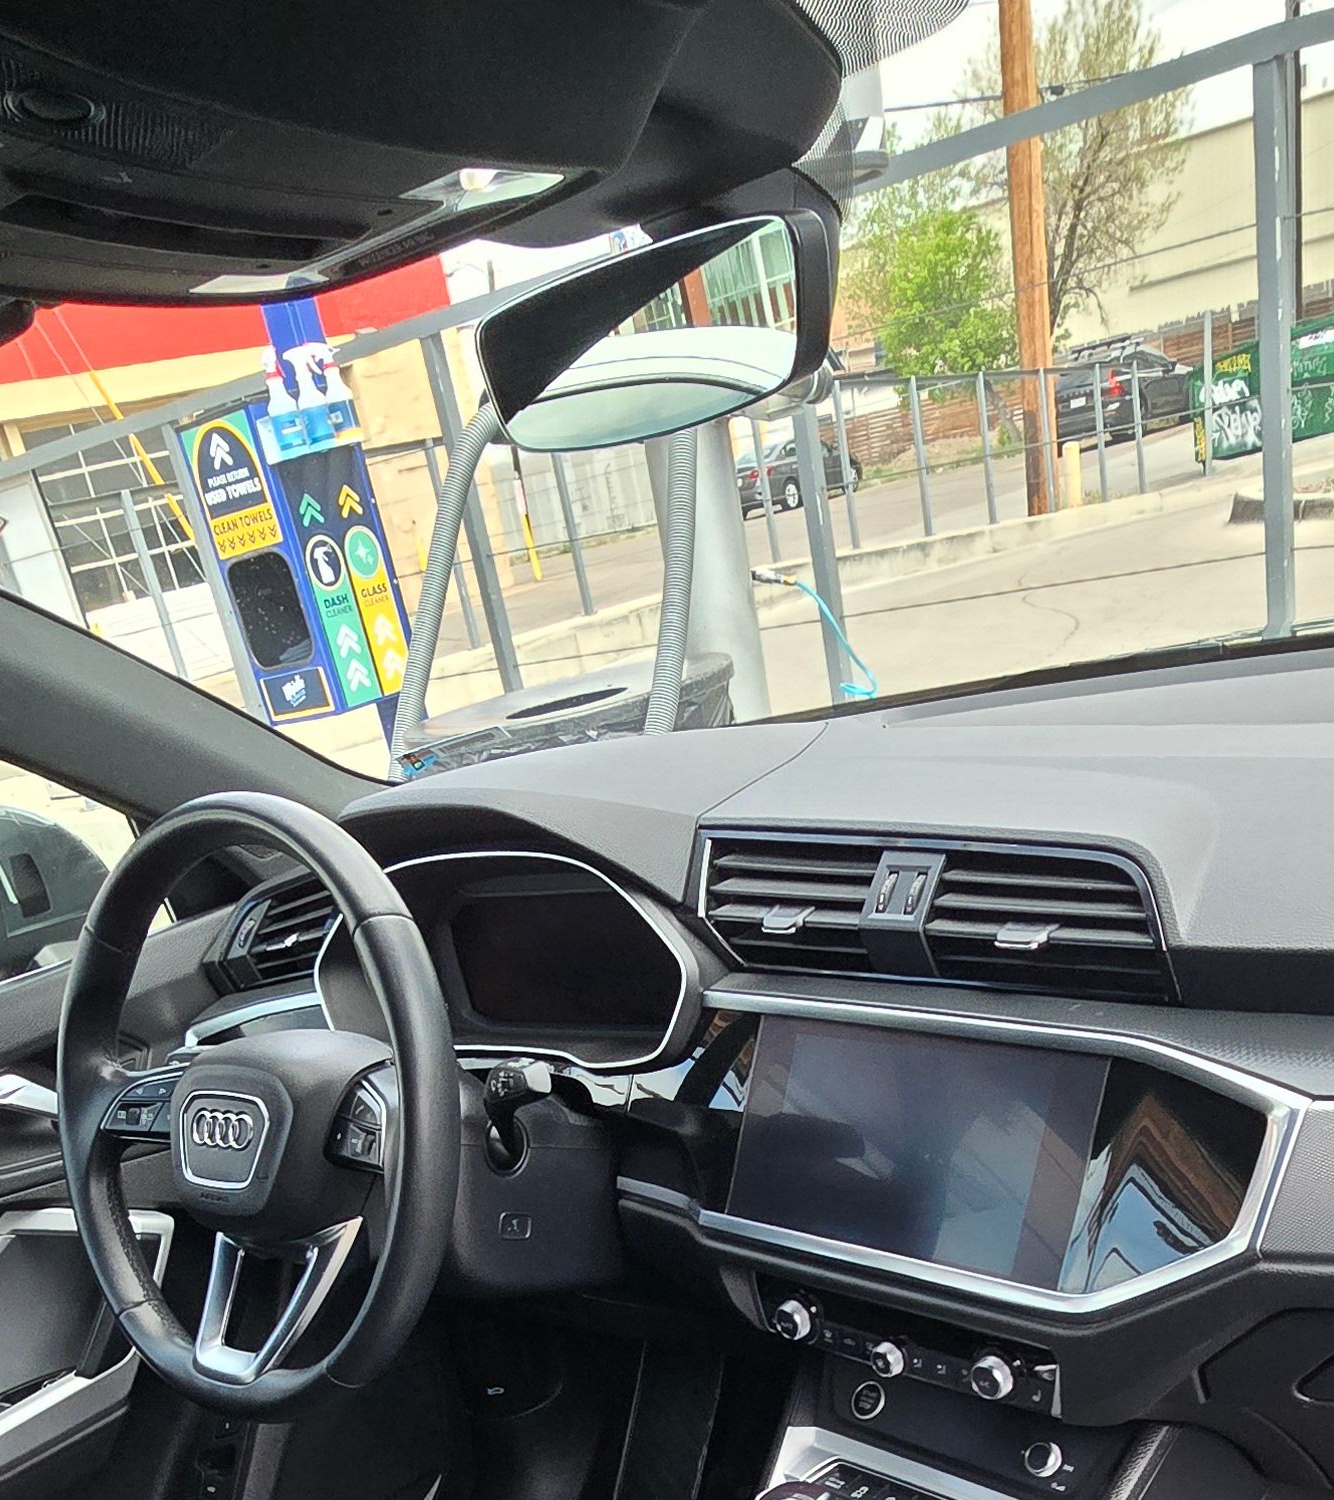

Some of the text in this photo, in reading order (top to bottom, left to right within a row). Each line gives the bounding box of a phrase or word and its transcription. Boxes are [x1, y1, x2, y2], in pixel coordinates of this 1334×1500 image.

[226, 477, 262, 501] TOWELS
[213, 507, 273, 536] CLEAN TOWELS
[361, 583, 388, 598] GLASS
[323, 593, 350, 609] DASH
[364, 594, 389, 608] CLEANER
[325, 605, 354, 619] CLEANER
